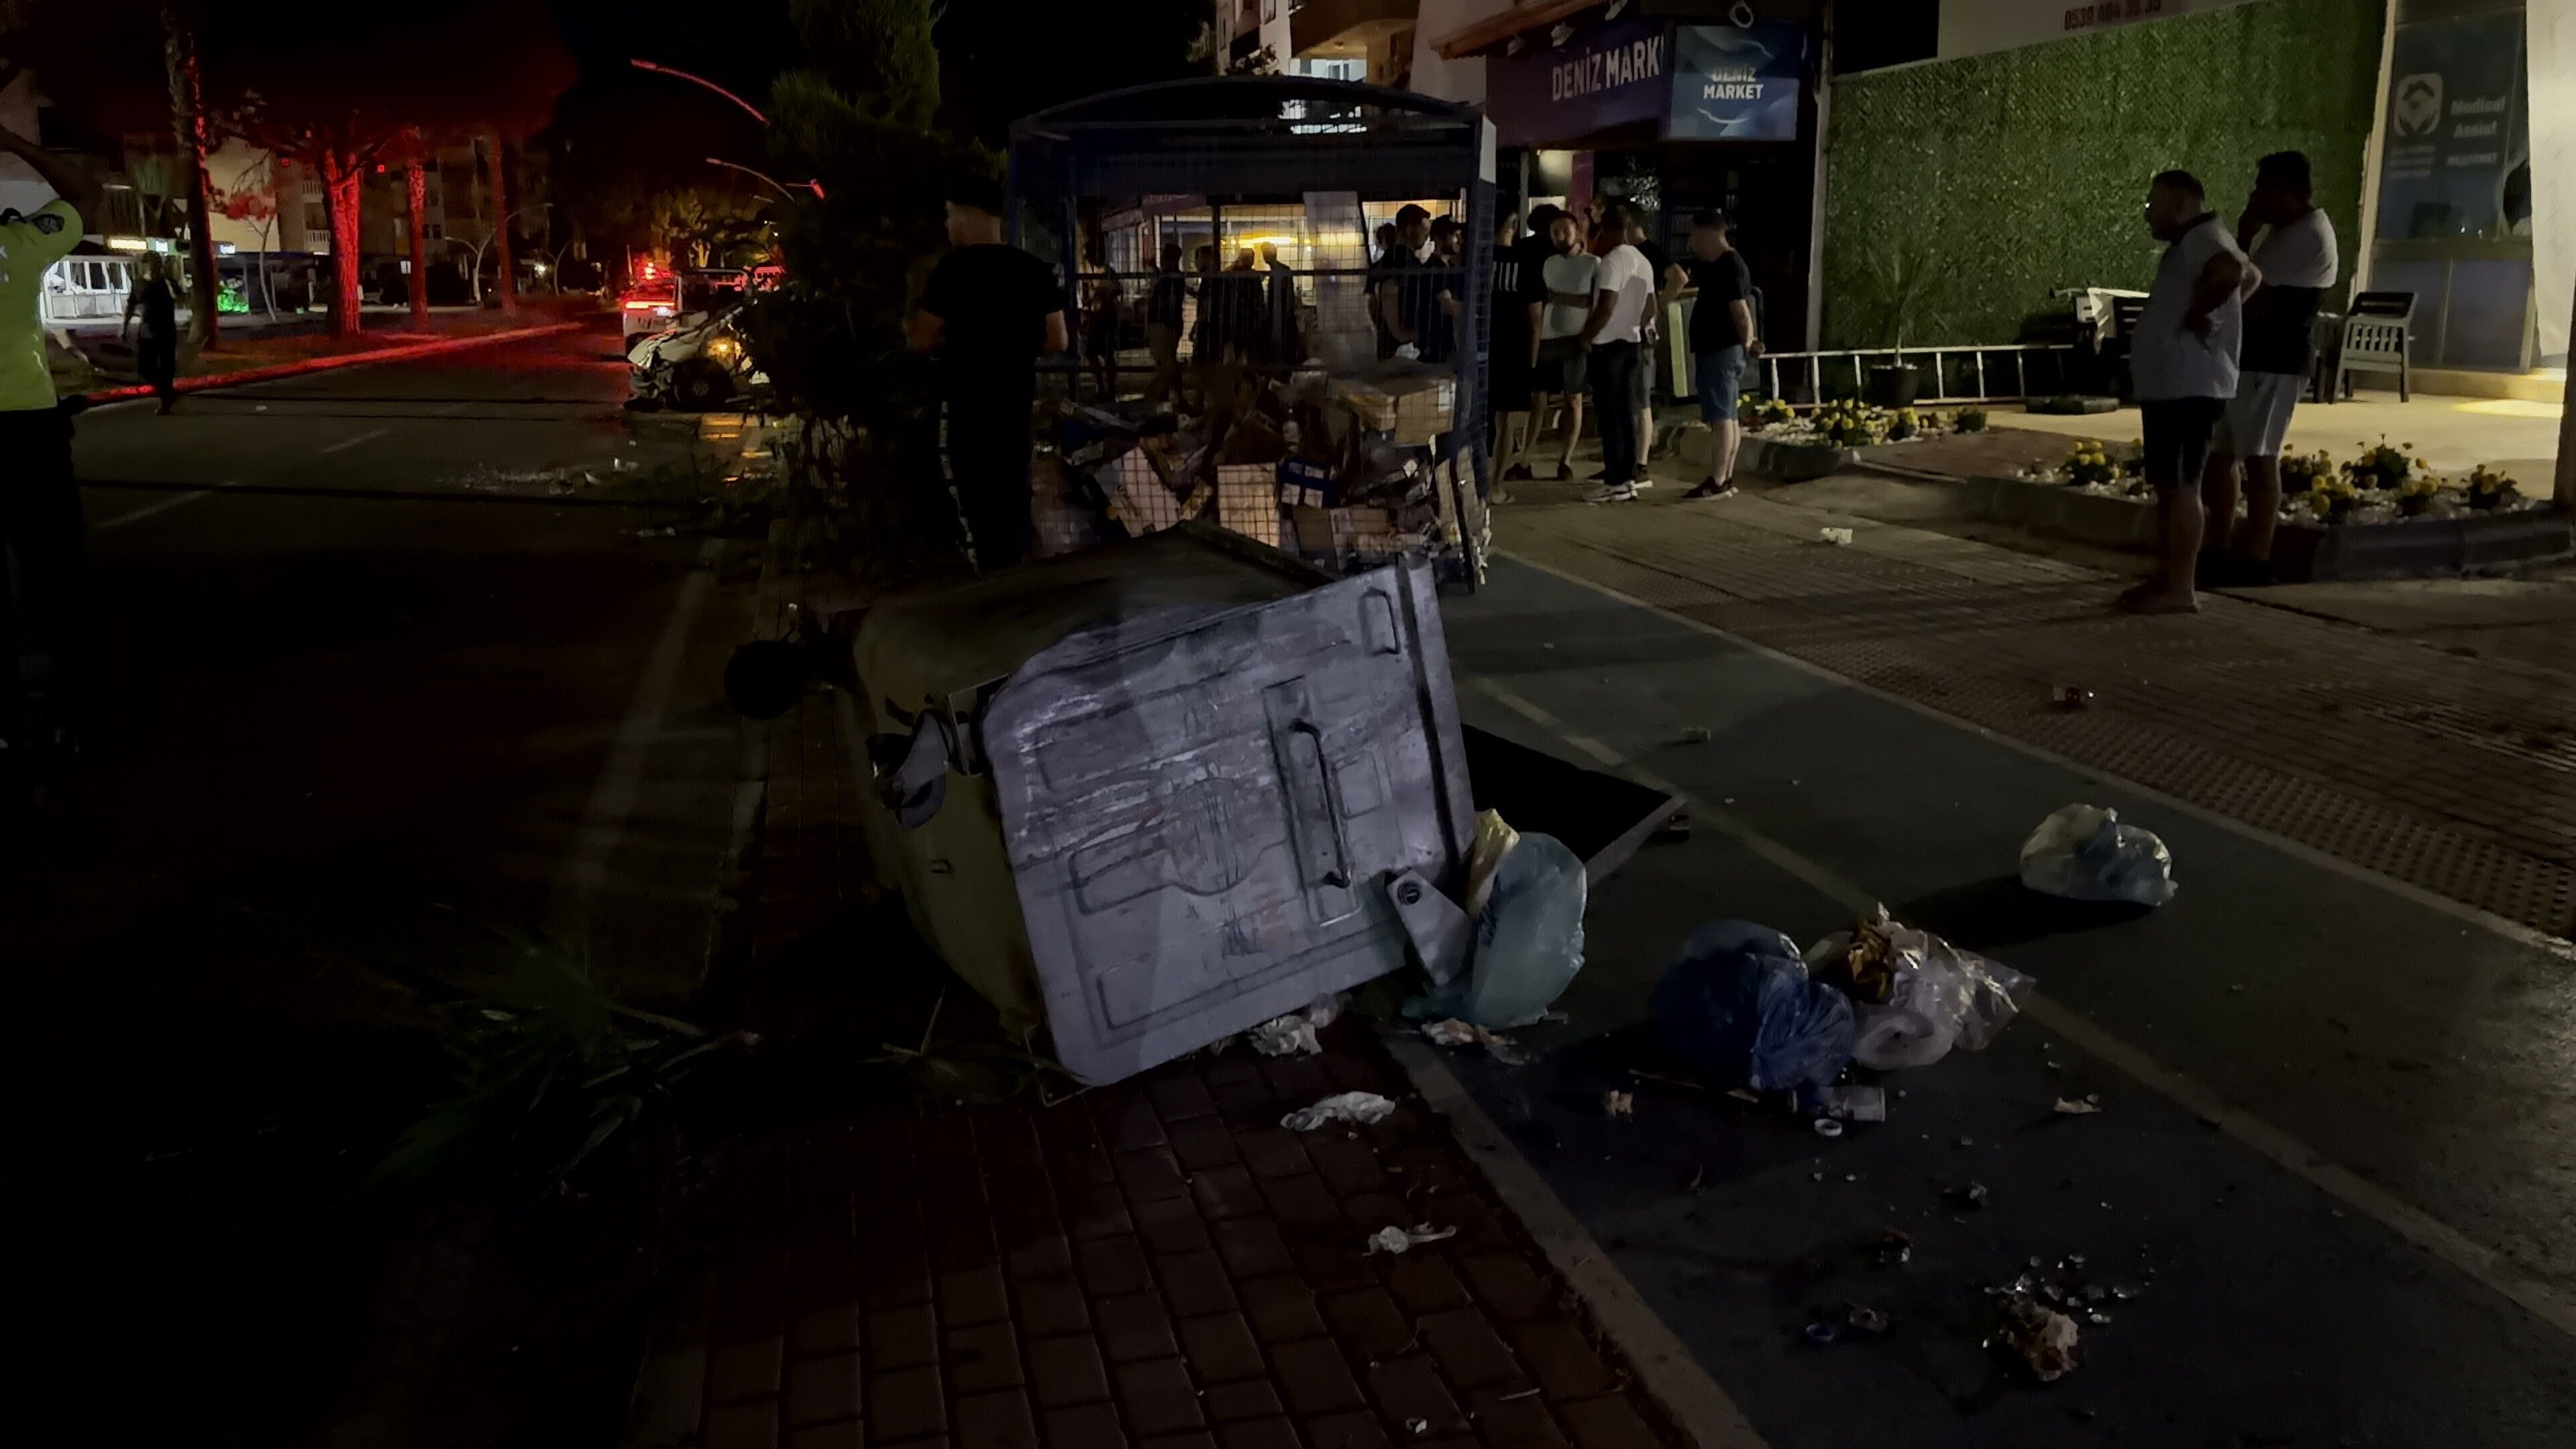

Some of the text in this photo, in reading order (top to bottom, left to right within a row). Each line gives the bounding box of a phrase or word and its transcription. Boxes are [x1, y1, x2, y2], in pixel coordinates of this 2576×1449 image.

[1552, 34, 1664, 102] DENİZ MARK
[1703, 83, 1764, 100] MARKET
